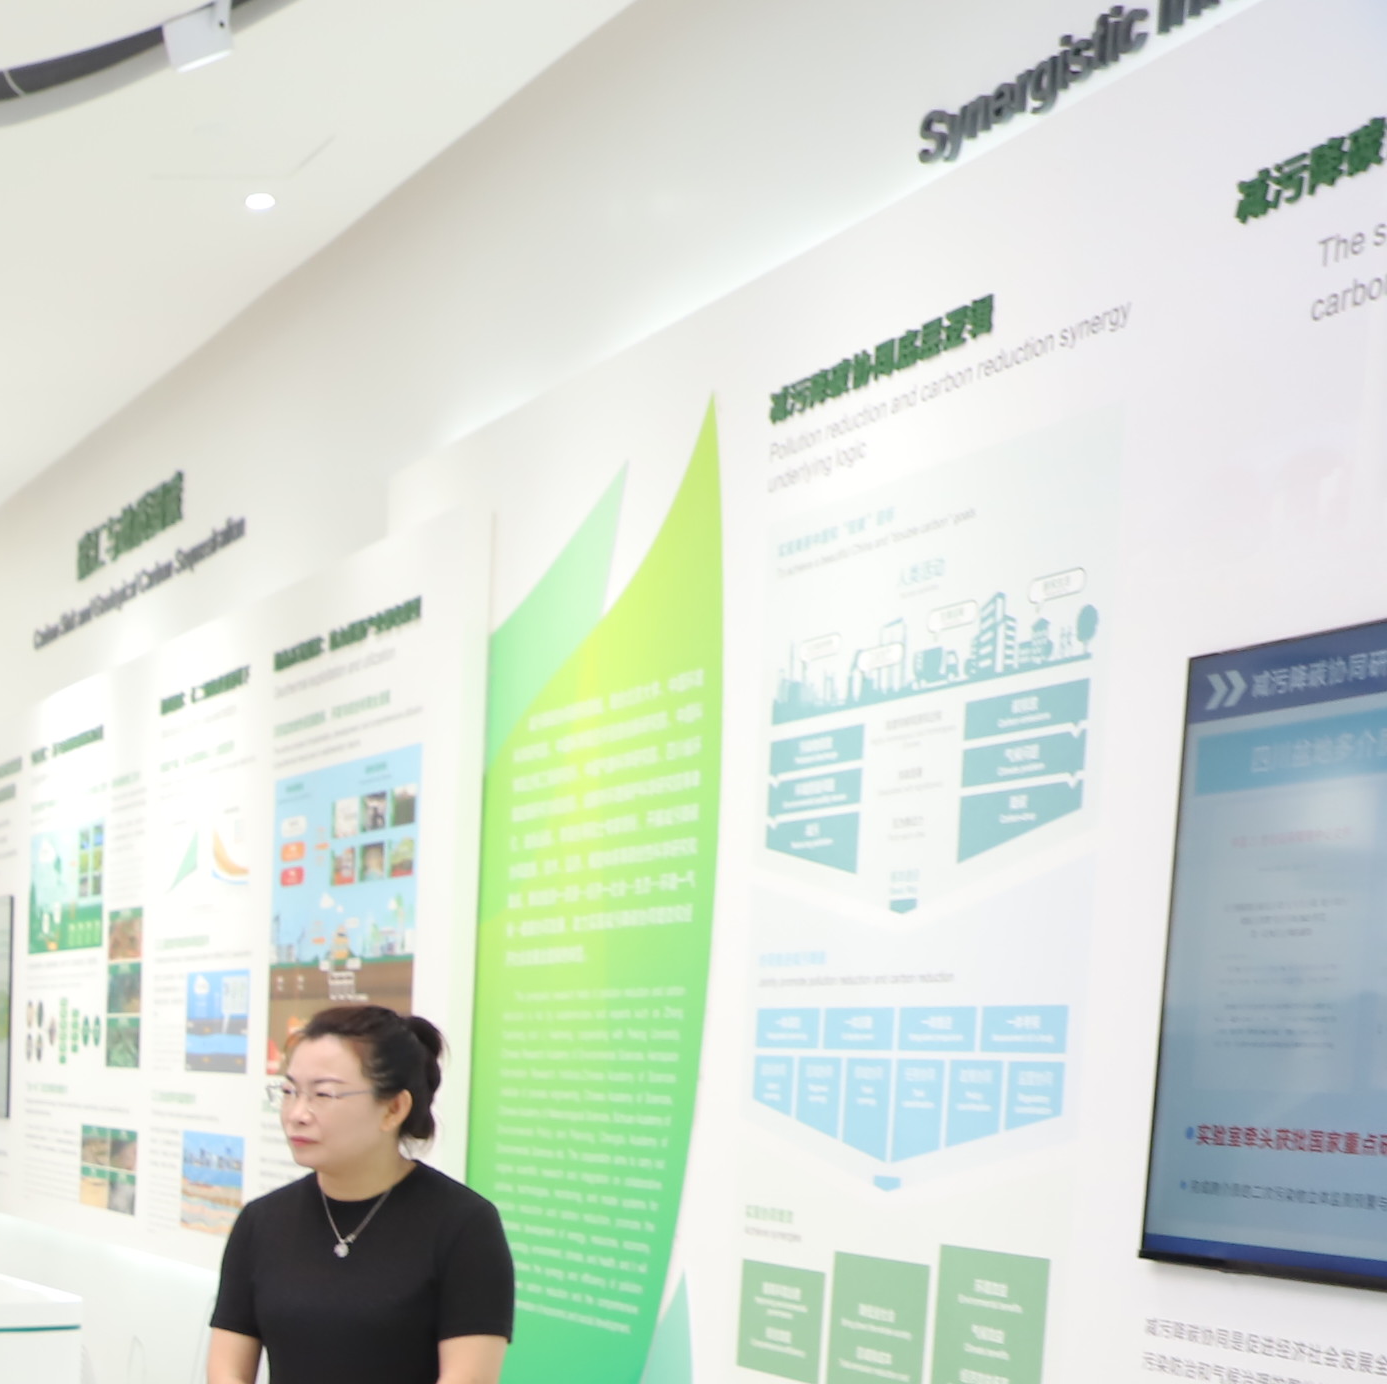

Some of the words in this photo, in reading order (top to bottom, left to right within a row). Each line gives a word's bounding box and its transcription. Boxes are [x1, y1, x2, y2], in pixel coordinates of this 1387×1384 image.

[918, 4, 1149, 164] Synergistic
[1318, 231, 1366, 267] The
[1310, 274, 1387, 321] carbo
[891, 390, 917, 416] and
[920, 367, 974, 402] carbon
[977, 335, 1055, 379] reduction
[1058, 302, 1132, 349] synergy
